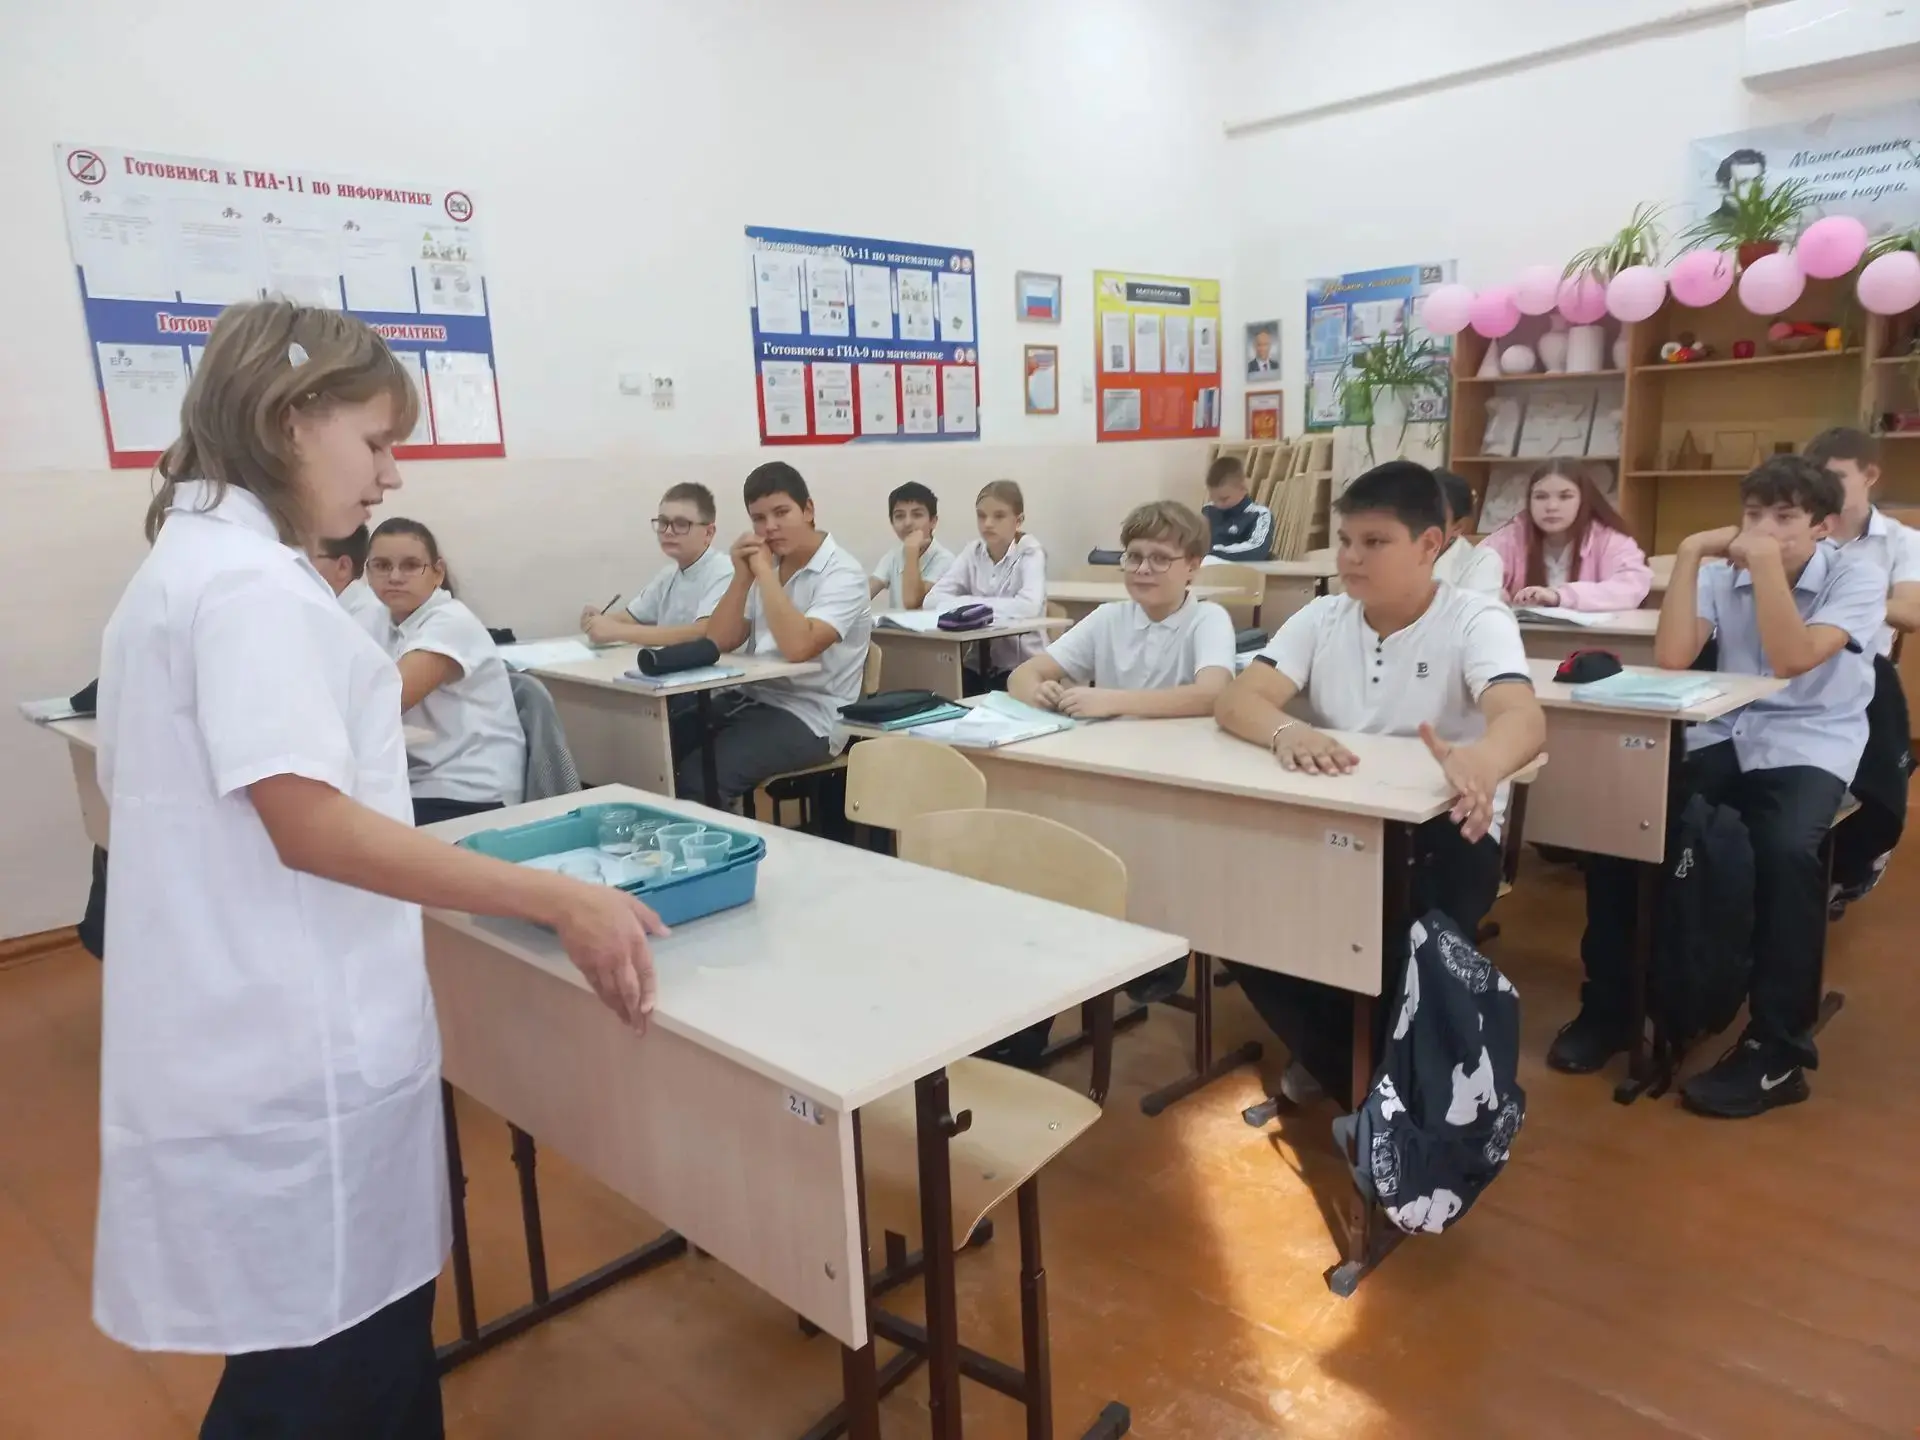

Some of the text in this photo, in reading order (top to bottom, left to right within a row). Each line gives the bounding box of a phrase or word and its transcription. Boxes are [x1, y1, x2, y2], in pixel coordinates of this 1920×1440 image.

[243, 170, 304, 193] ГИА-11
[1813, 163, 1892, 185] котором
[887, 253, 945, 268] математике
[762, 341, 825, 356] Готовимся
[837, 344, 869, 358] ГИА-9
[871, 349, 884, 359] по
[886, 350, 944, 361] математике
